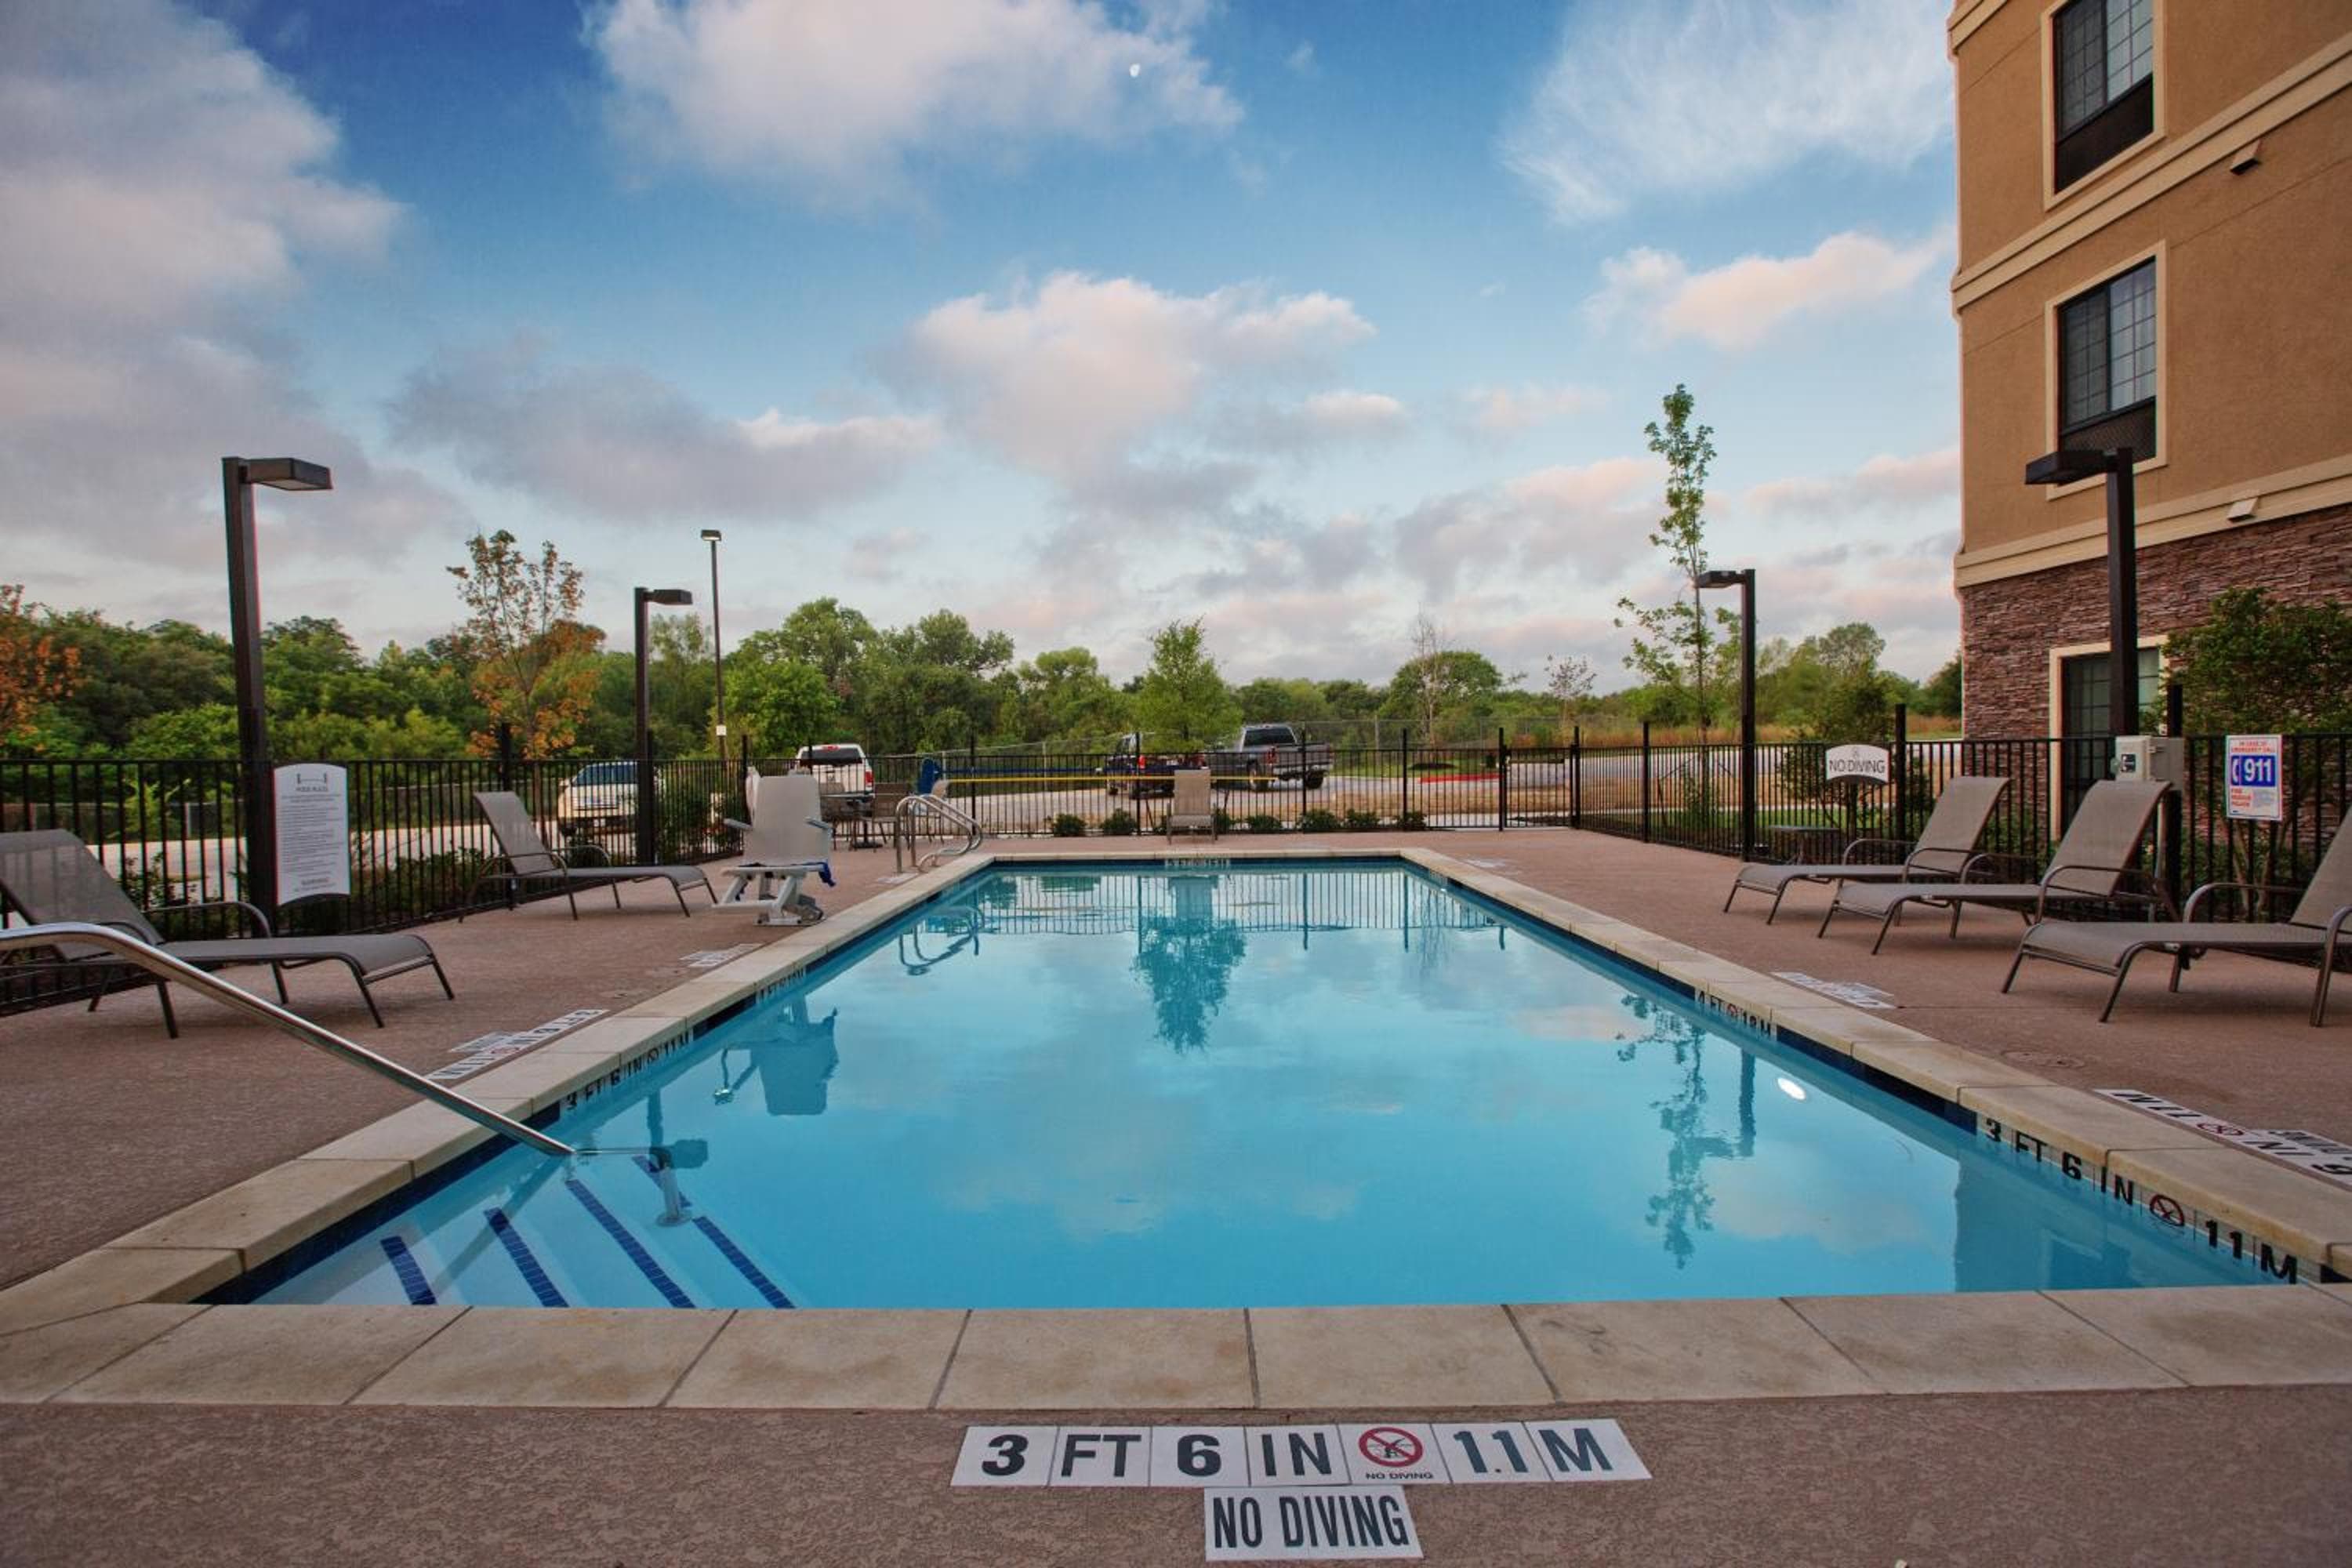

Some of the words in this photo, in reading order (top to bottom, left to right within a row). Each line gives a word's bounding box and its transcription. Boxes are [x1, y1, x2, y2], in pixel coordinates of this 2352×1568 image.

[1829, 759, 1846, 772] NO
[1848, 760, 1886, 774] DIVING
[2244, 758, 2272, 782] 911
[1985, 1118, 2002, 1142] 3
[2015, 1131, 2049, 1163] FT
[2062, 1152, 2082, 1181] 6
[2100, 1166, 2135, 1206] IN
[2260, 1243, 2298, 1285] M
[982, 1434, 1029, 1477] 3
[1061, 1434, 1142, 1478] FT
[1177, 1434, 1223, 1477] 6
[1261, 1432, 1332, 1478] IN
[1453, 1430, 1530, 1474] 1.1
[1538, 1428, 1613, 1472] M
[1389, 1472, 1434, 1480] DIVING
[1213, 1497, 1263, 1548] NO
[1278, 1494, 1410, 1548] DIVING
